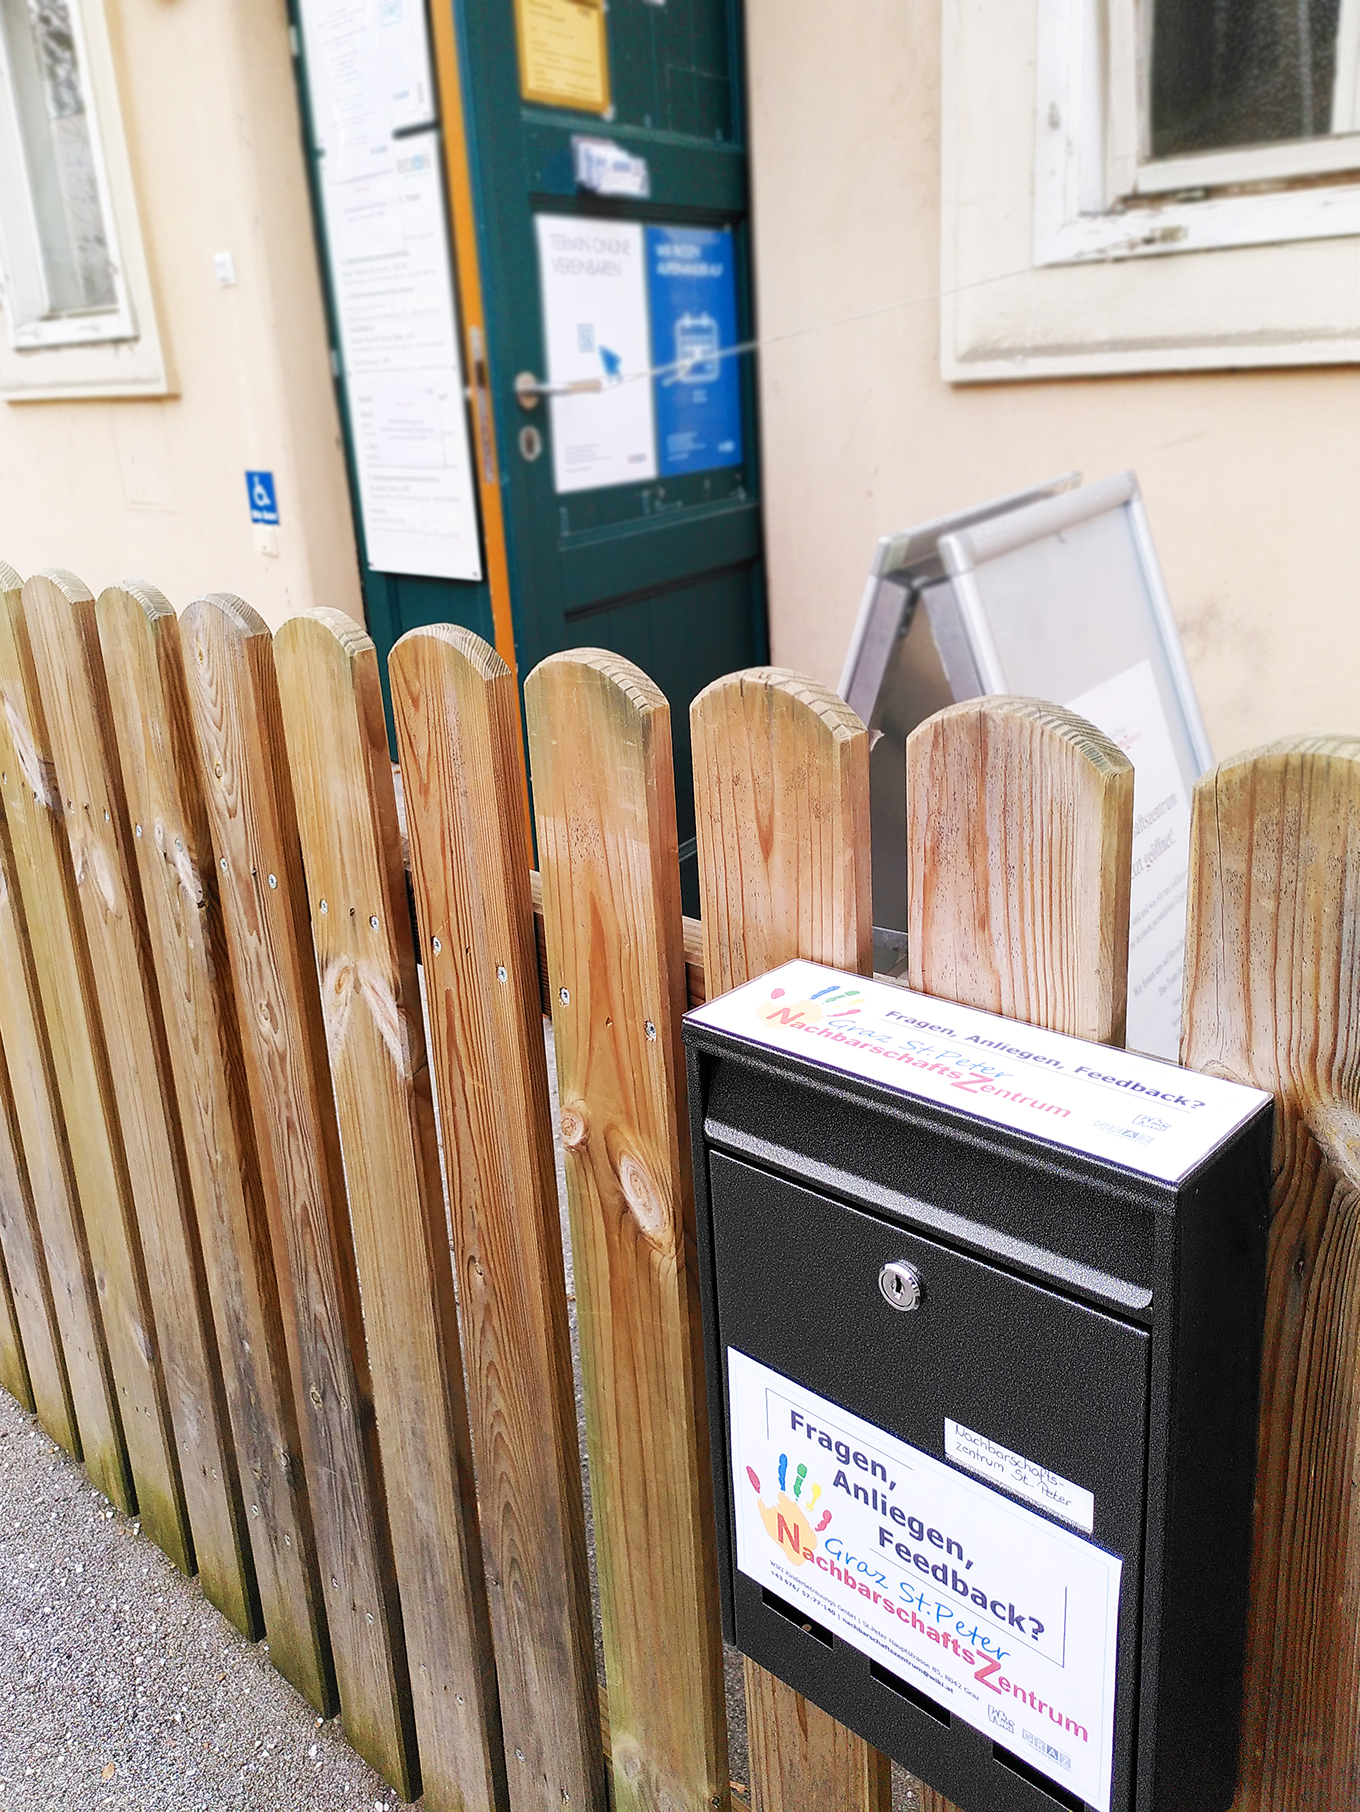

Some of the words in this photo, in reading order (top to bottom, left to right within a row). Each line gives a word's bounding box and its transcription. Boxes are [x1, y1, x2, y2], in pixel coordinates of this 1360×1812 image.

[765, 1007, 1071, 1118] NachbarschaftsZentrum
[828, 1019, 892, 1044] Graz
[885, 1010, 957, 1038] Fragen,
[964, 1034, 1065, 1070] Anliegen,
[1073, 1065, 1206, 1110] Feedback?
[790, 1409, 897, 1491] Fragen,
[955, 1424, 1065, 1487] Nachbarschafts-
[1037, 1481, 1073, 1506] Peter
[825, 1538, 889, 1589] Graz
[832, 1469, 974, 1570] Anliegen,
[770, 1570, 783, 1582] +43
[879, 1525, 1045, 1642] Feedback?
[770, 1560, 784, 1574] WIKI
[837, 1604, 857, 1621] GmbH
[945, 1674, 962, 1690] 8042
[964, 1687, 980, 1702] Graz
[777, 1512, 1088, 1743] NachbarschaftsZentrum
